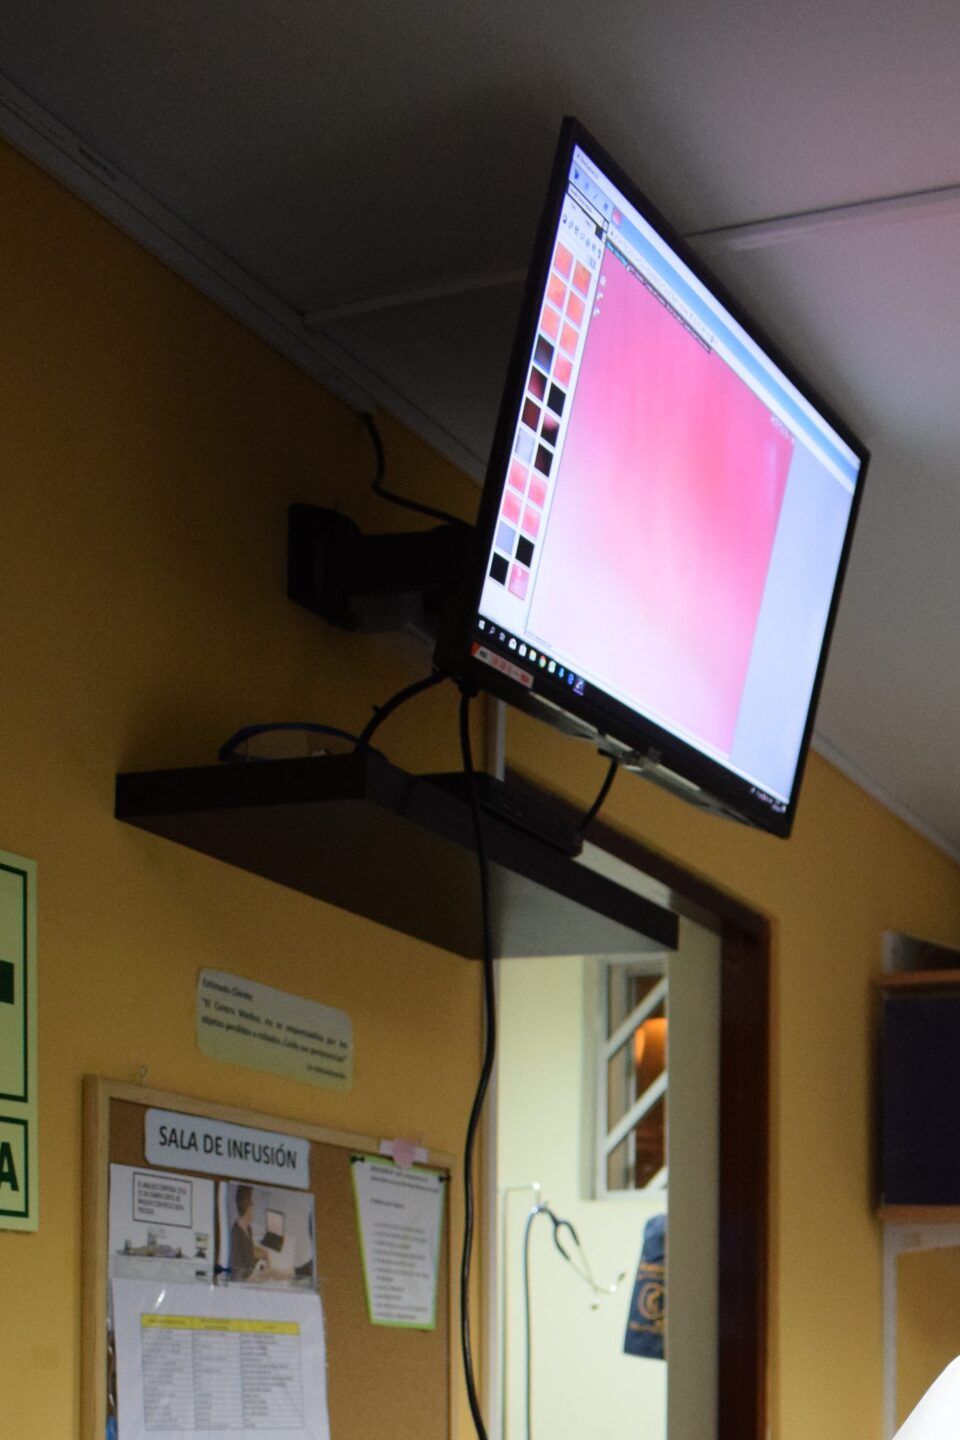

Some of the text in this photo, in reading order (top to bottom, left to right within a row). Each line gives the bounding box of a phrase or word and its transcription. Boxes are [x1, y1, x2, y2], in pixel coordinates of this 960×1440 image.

[159, 1125, 298, 1169] SALA DE INFUSIÓN
